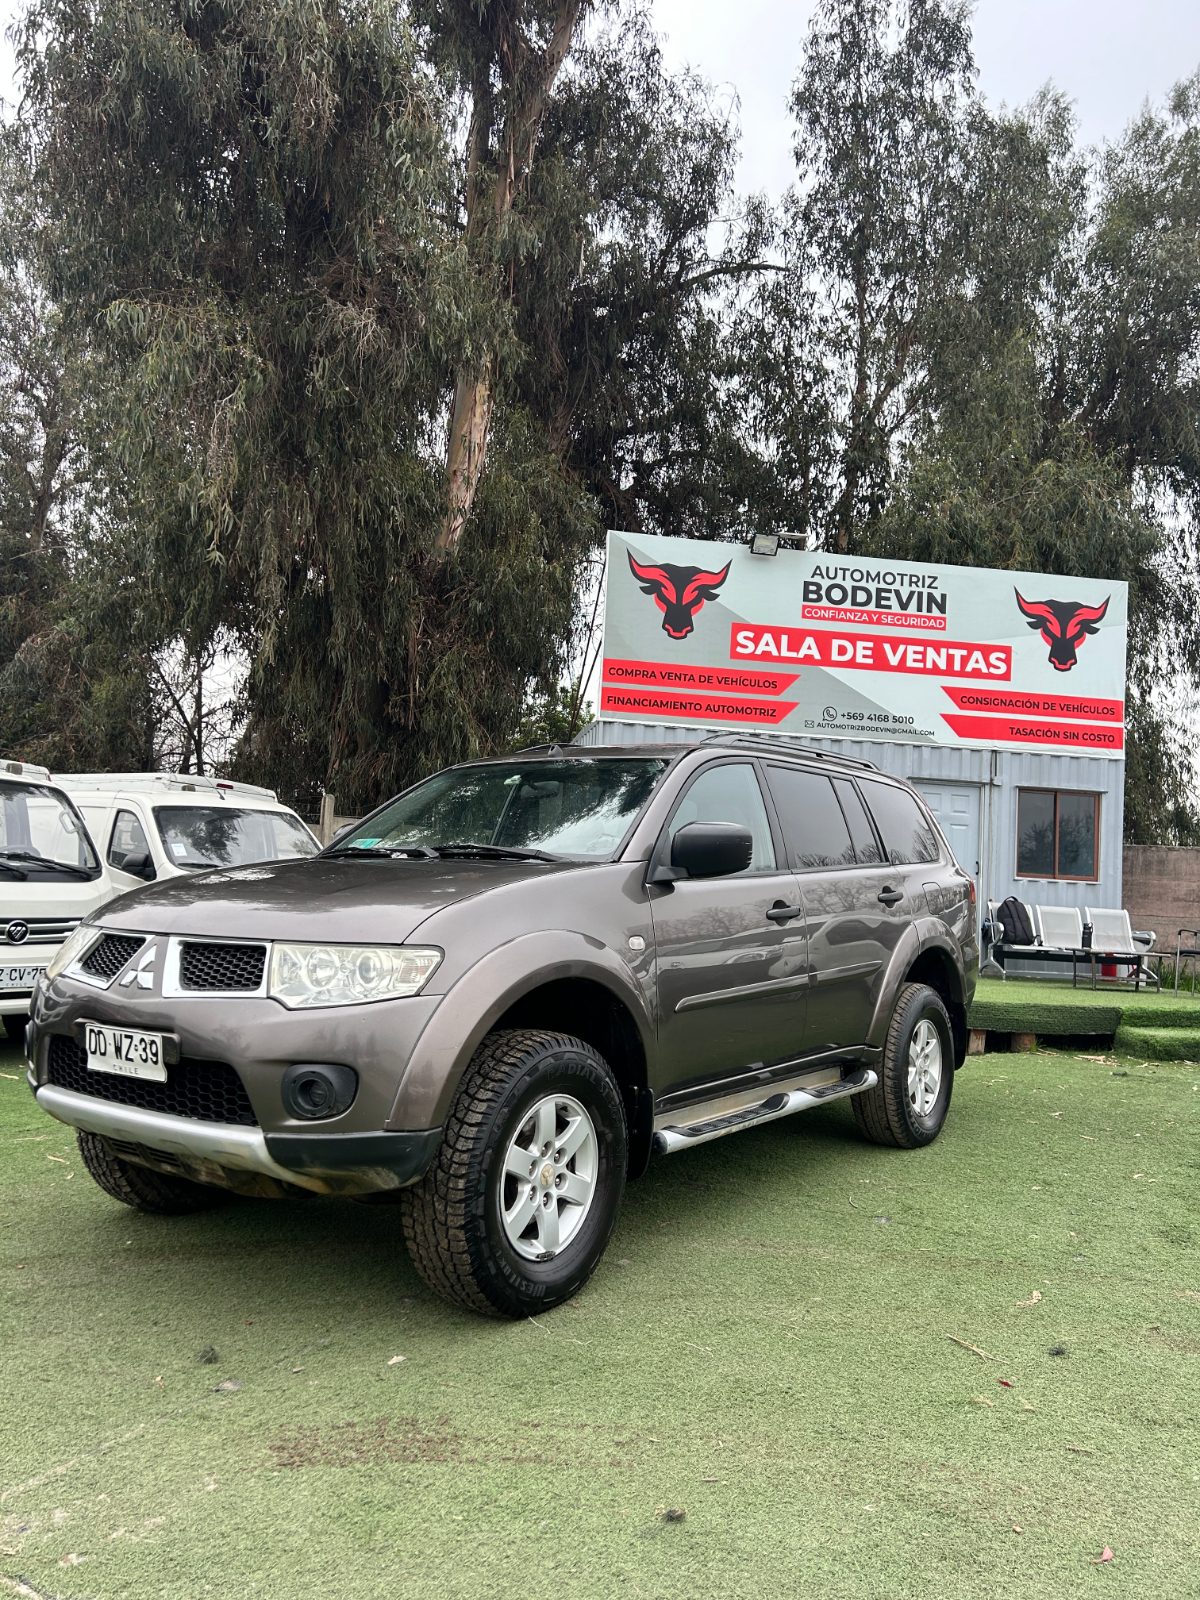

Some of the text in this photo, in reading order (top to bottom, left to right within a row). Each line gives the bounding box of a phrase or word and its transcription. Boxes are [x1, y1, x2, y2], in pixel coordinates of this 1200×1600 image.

[811, 565, 938, 590] AUTOMOTRIZ
[803, 581, 947, 615] BODEVIN
[804, 608, 945, 629] CONFIANZA Y SEGURIDAD
[735, 630, 1008, 676] SALA DE VENTAS
[608, 667, 778, 689] COMPRA VENTA DE VEHÍCULOS
[607, 695, 777, 718] FINANCIAMIENTO AUTOMOTRIZ
[960, 694, 1116, 716] CONSIGNACIÓN DE VEHÍCULOS
[840, 710, 915, 725] +569 4168 5010
[816, 722, 935, 737] AUTOMOTRIZBODEVIN@GMAIL.COM
[1009, 726, 1116, 744] TASACIÓN SIN COSTO
[112, 1063, 139, 1075] CHILE
